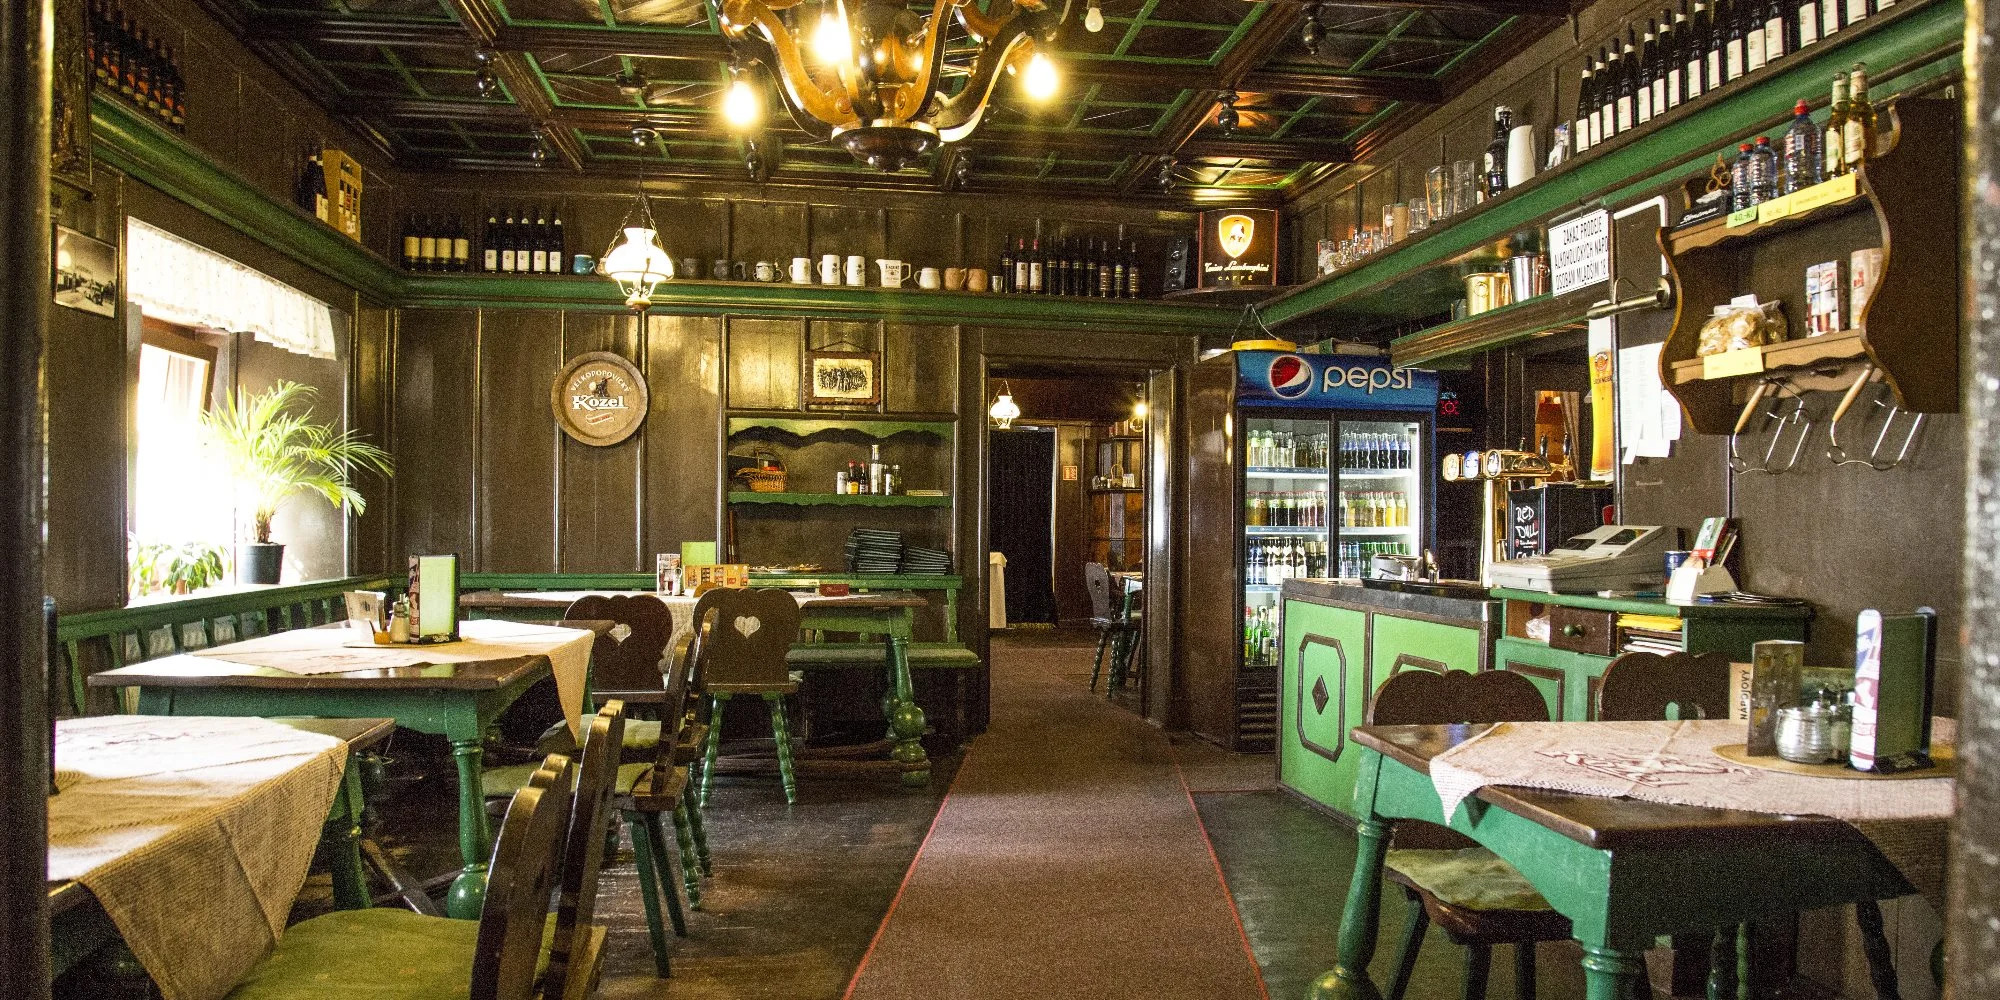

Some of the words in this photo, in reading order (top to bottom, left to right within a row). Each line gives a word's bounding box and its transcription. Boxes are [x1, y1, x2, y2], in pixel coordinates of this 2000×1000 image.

[571, 370, 631, 391] VELKOPOPOVICKÝ
[1322, 365, 1412, 395] pepsi
[572, 395, 628, 411] Kozel
[1515, 505, 1535, 523] RED
